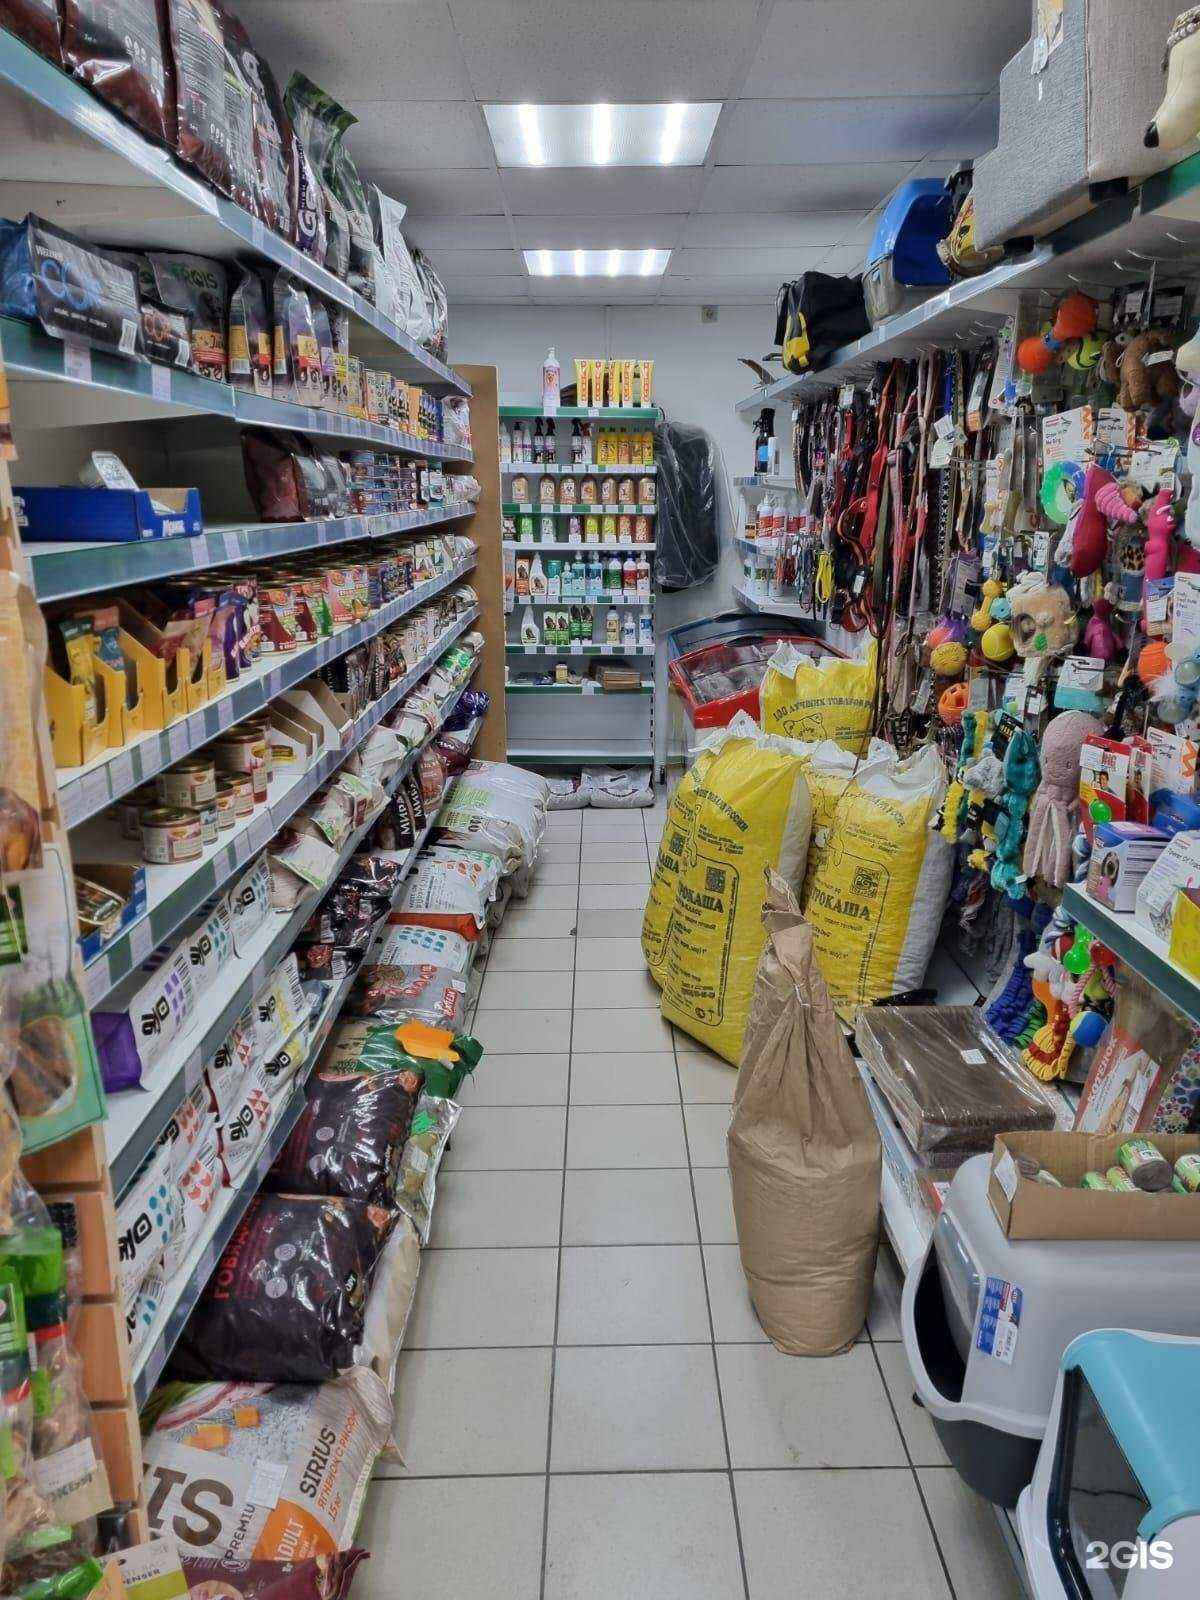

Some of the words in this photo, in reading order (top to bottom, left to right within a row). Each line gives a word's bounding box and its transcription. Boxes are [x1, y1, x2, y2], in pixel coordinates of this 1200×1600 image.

[772, 705, 788, 721] 100
[299, 1426, 336, 1498] SIRIUS
[143, 1463, 233, 1547] TS
[223, 1504, 256, 1561] PREMIU
